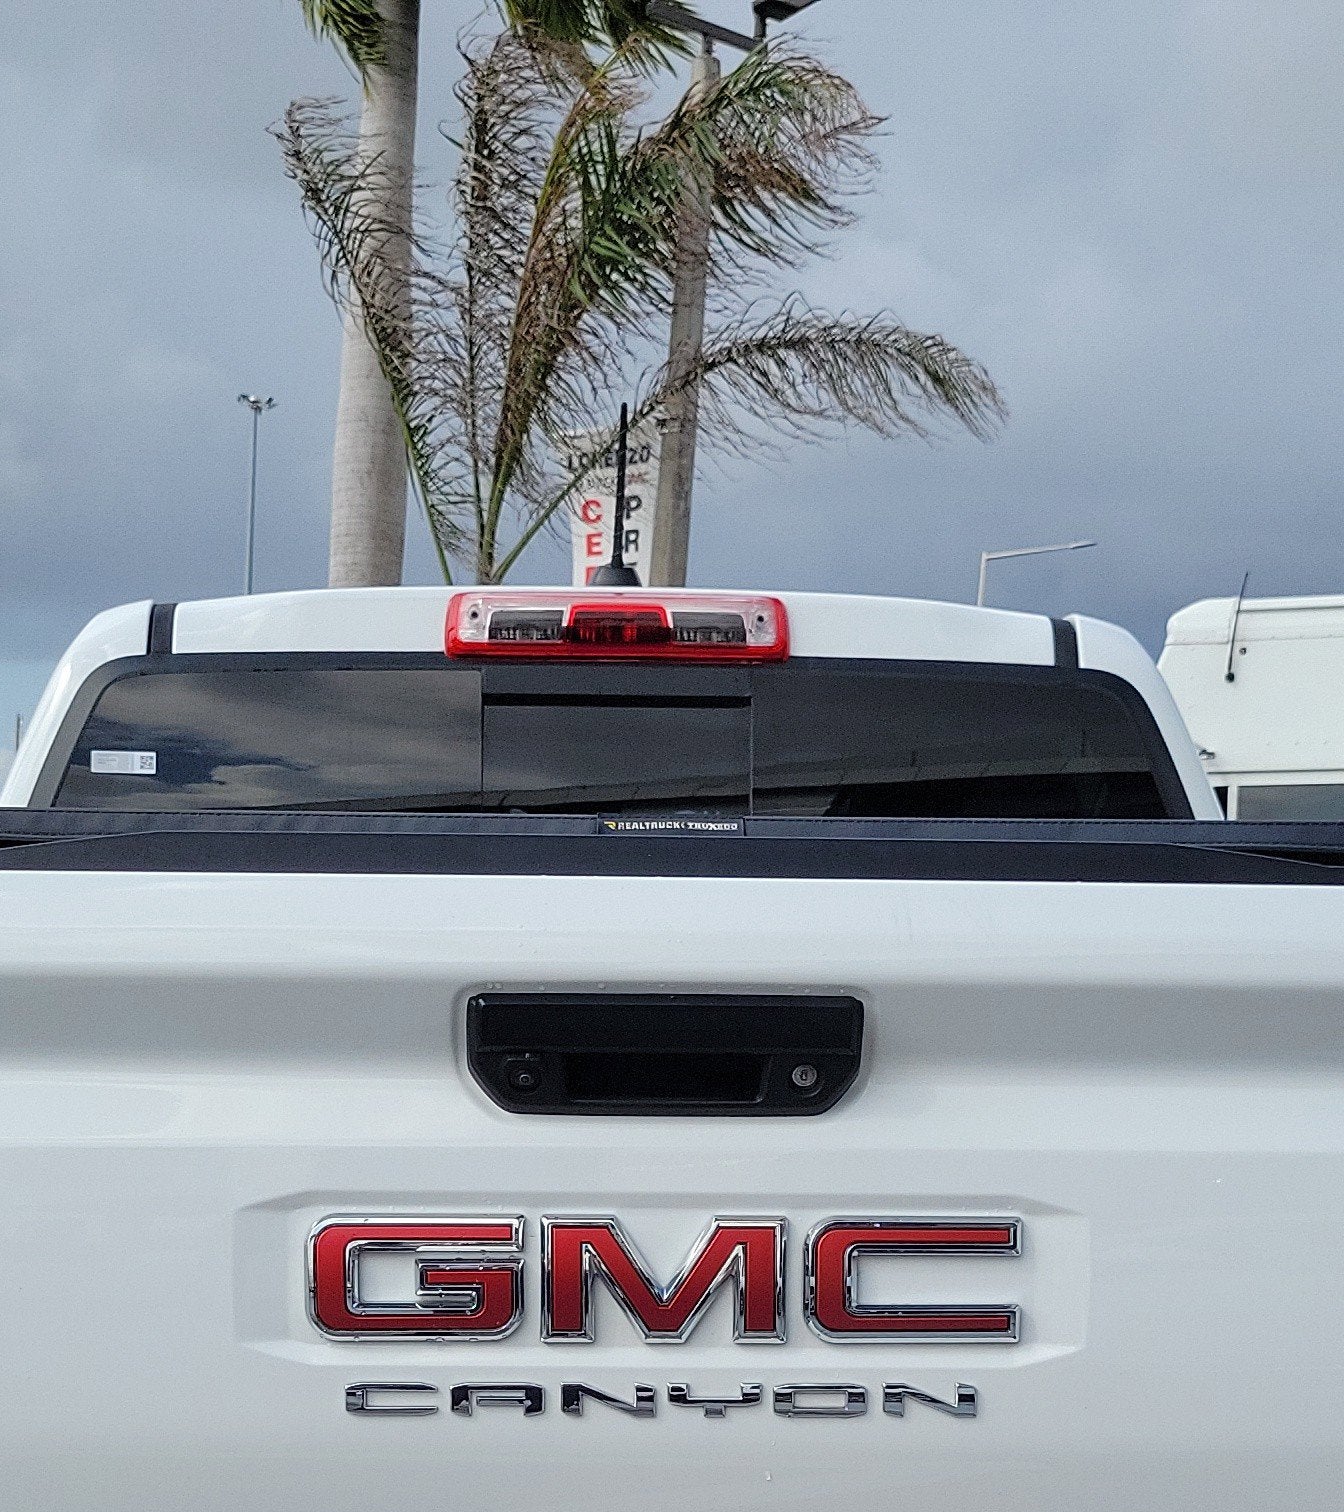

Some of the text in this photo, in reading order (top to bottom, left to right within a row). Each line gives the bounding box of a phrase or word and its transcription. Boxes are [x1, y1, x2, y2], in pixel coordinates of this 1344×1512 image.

[618, 821, 680, 830] REALTRUCK
[305, 1213, 1023, 1344] GMC
[344, 1382, 978, 1418] CANYON
